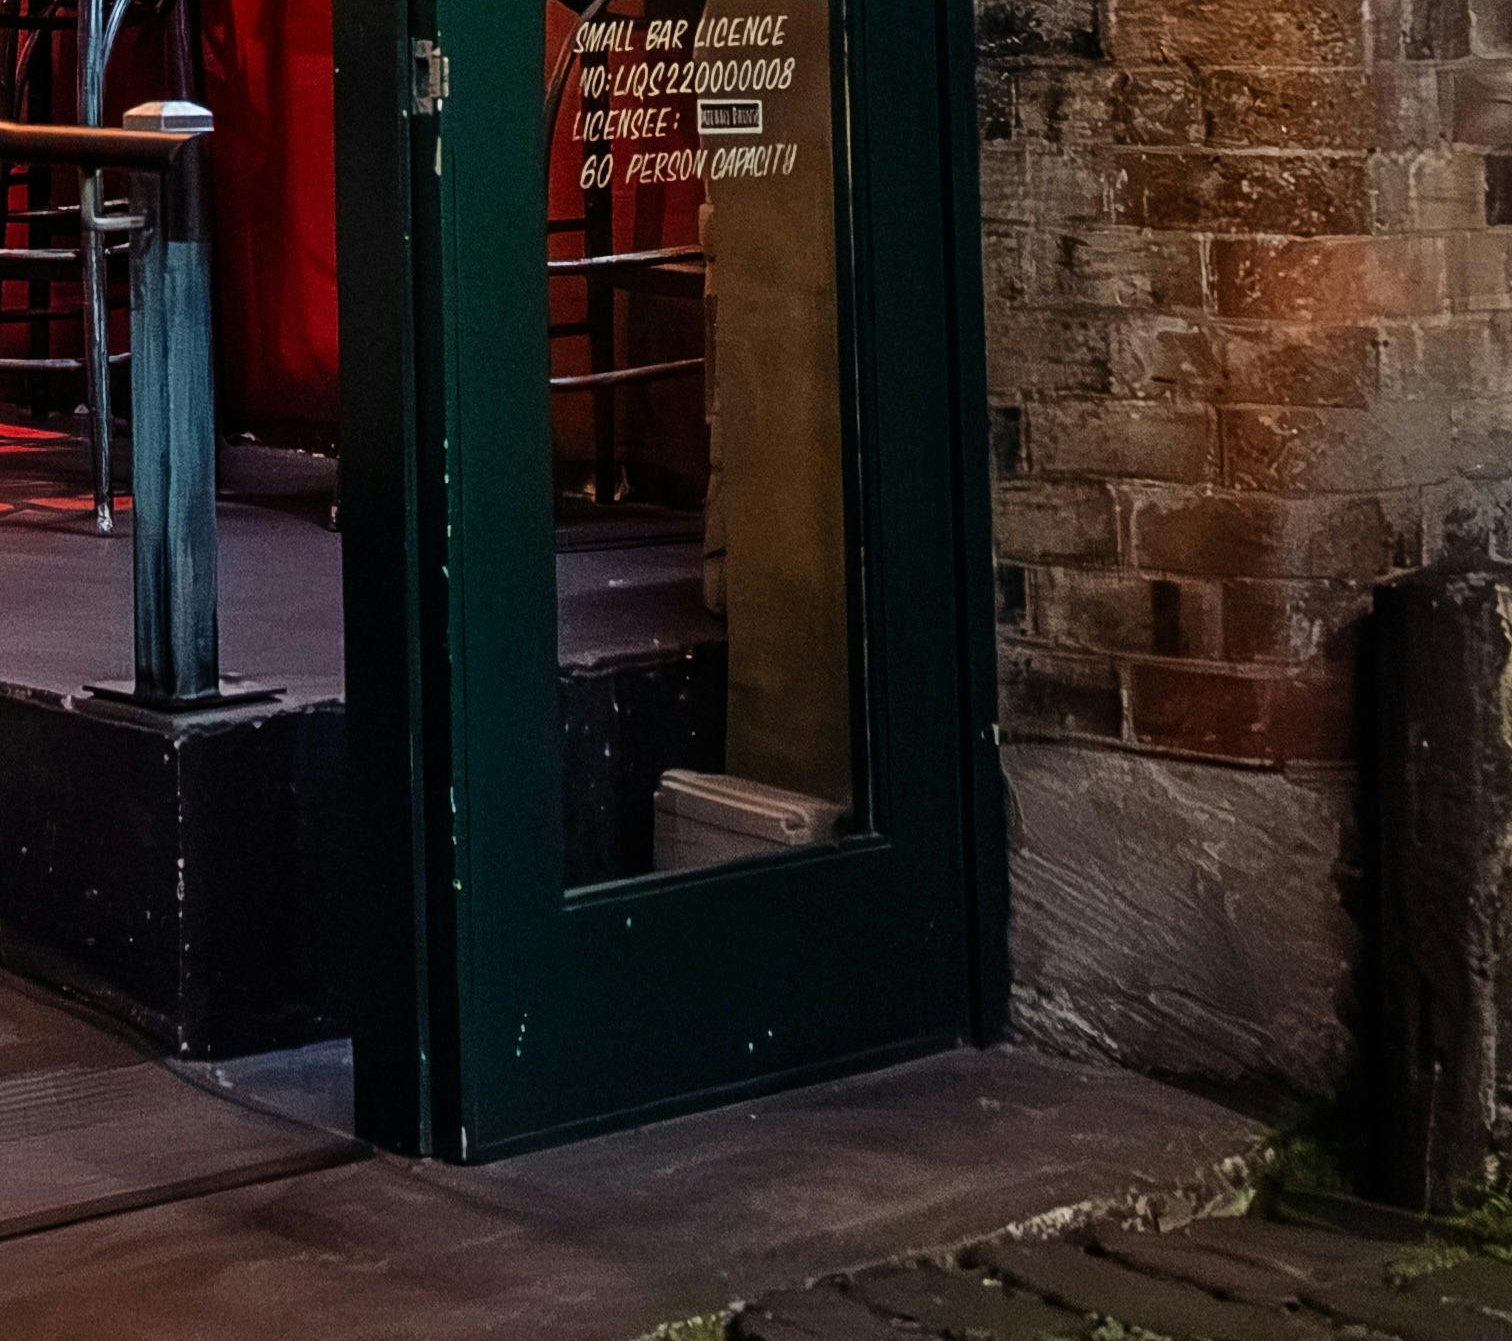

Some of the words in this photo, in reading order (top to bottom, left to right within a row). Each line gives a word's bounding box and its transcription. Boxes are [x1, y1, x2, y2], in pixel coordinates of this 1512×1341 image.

[573, 18, 634, 54] SMALL
[645, 19, 689, 50] BAR
[693, 15, 789, 48] LICENCE
[572, 107, 682, 142] LICENSEE:
[579, 154, 614, 189] 60
[625, 149, 706, 186] PERSON
[711, 143, 798, 180] CAPACITY
